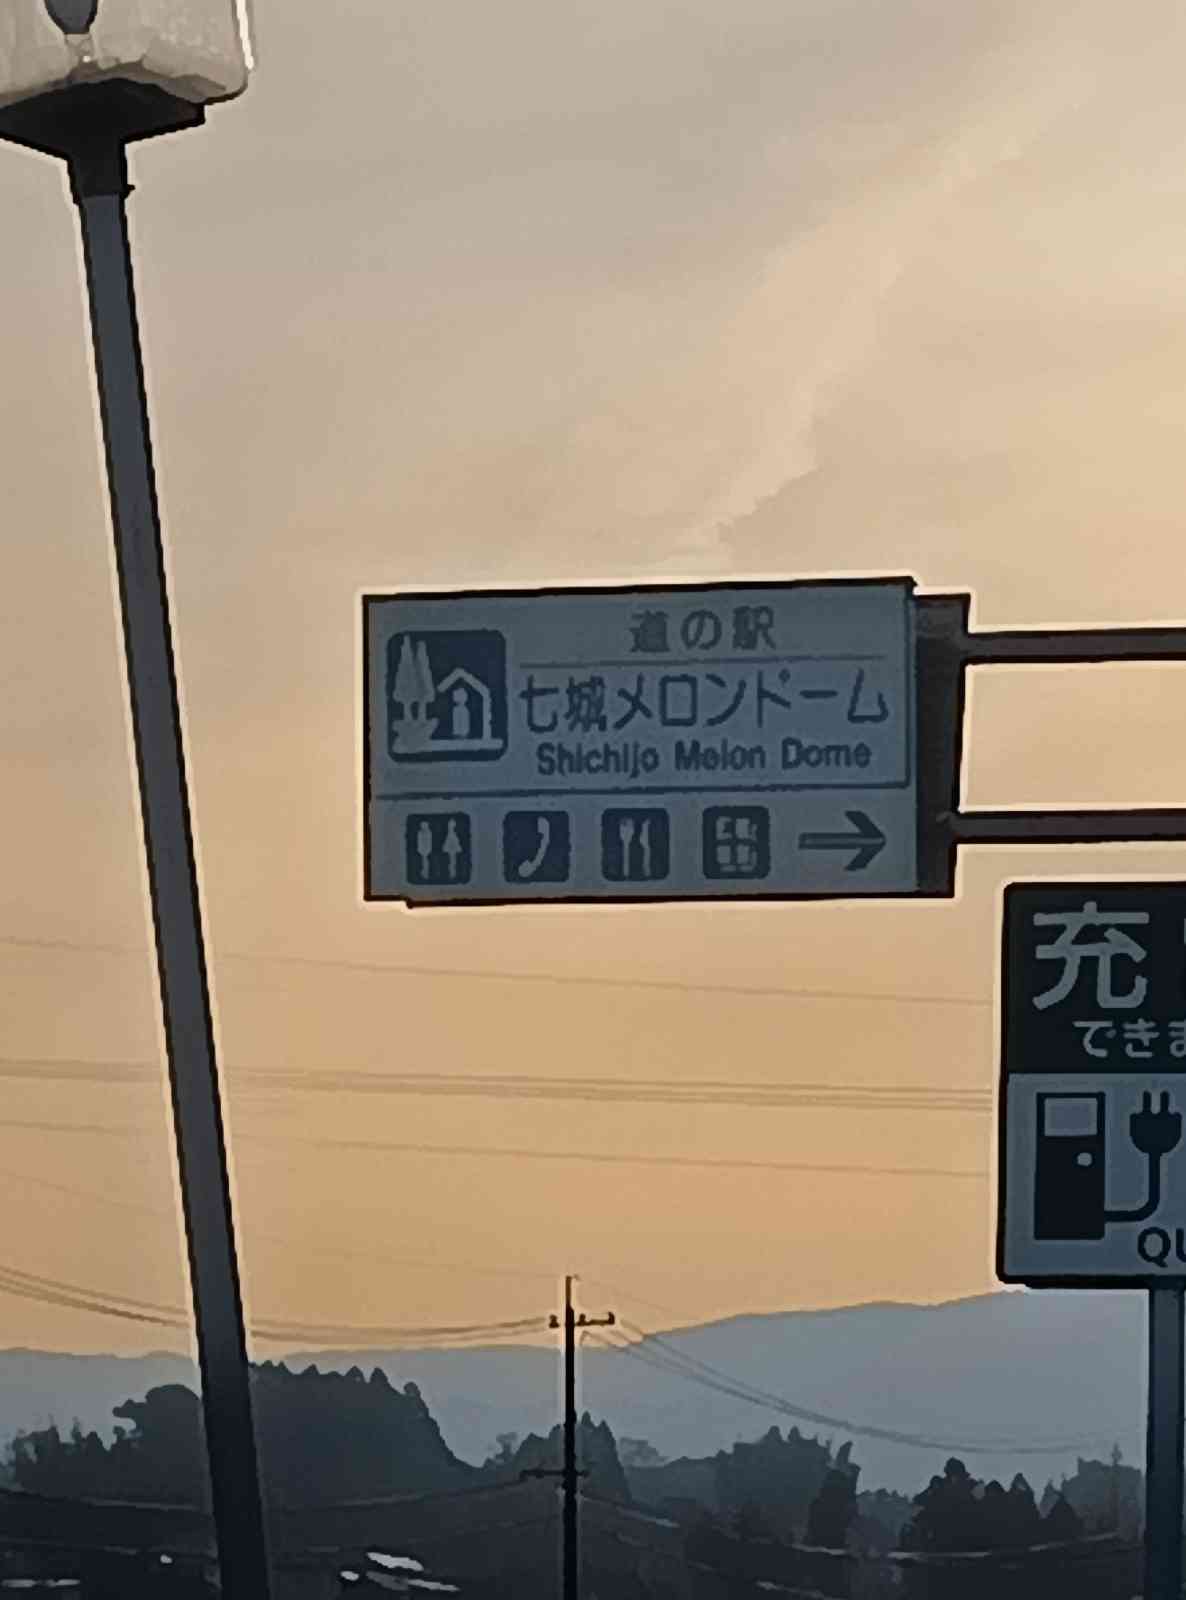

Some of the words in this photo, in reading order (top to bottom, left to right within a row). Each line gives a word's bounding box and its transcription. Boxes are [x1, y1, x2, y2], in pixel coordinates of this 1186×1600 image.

[629, 606, 777, 652] 道の駅
[519, 669, 889, 733] 七城メロンドーム
[536, 741, 659, 779] Shichijo
[781, 736, 873, 770] Dome
[1032, 900, 1186, 1010] 充
